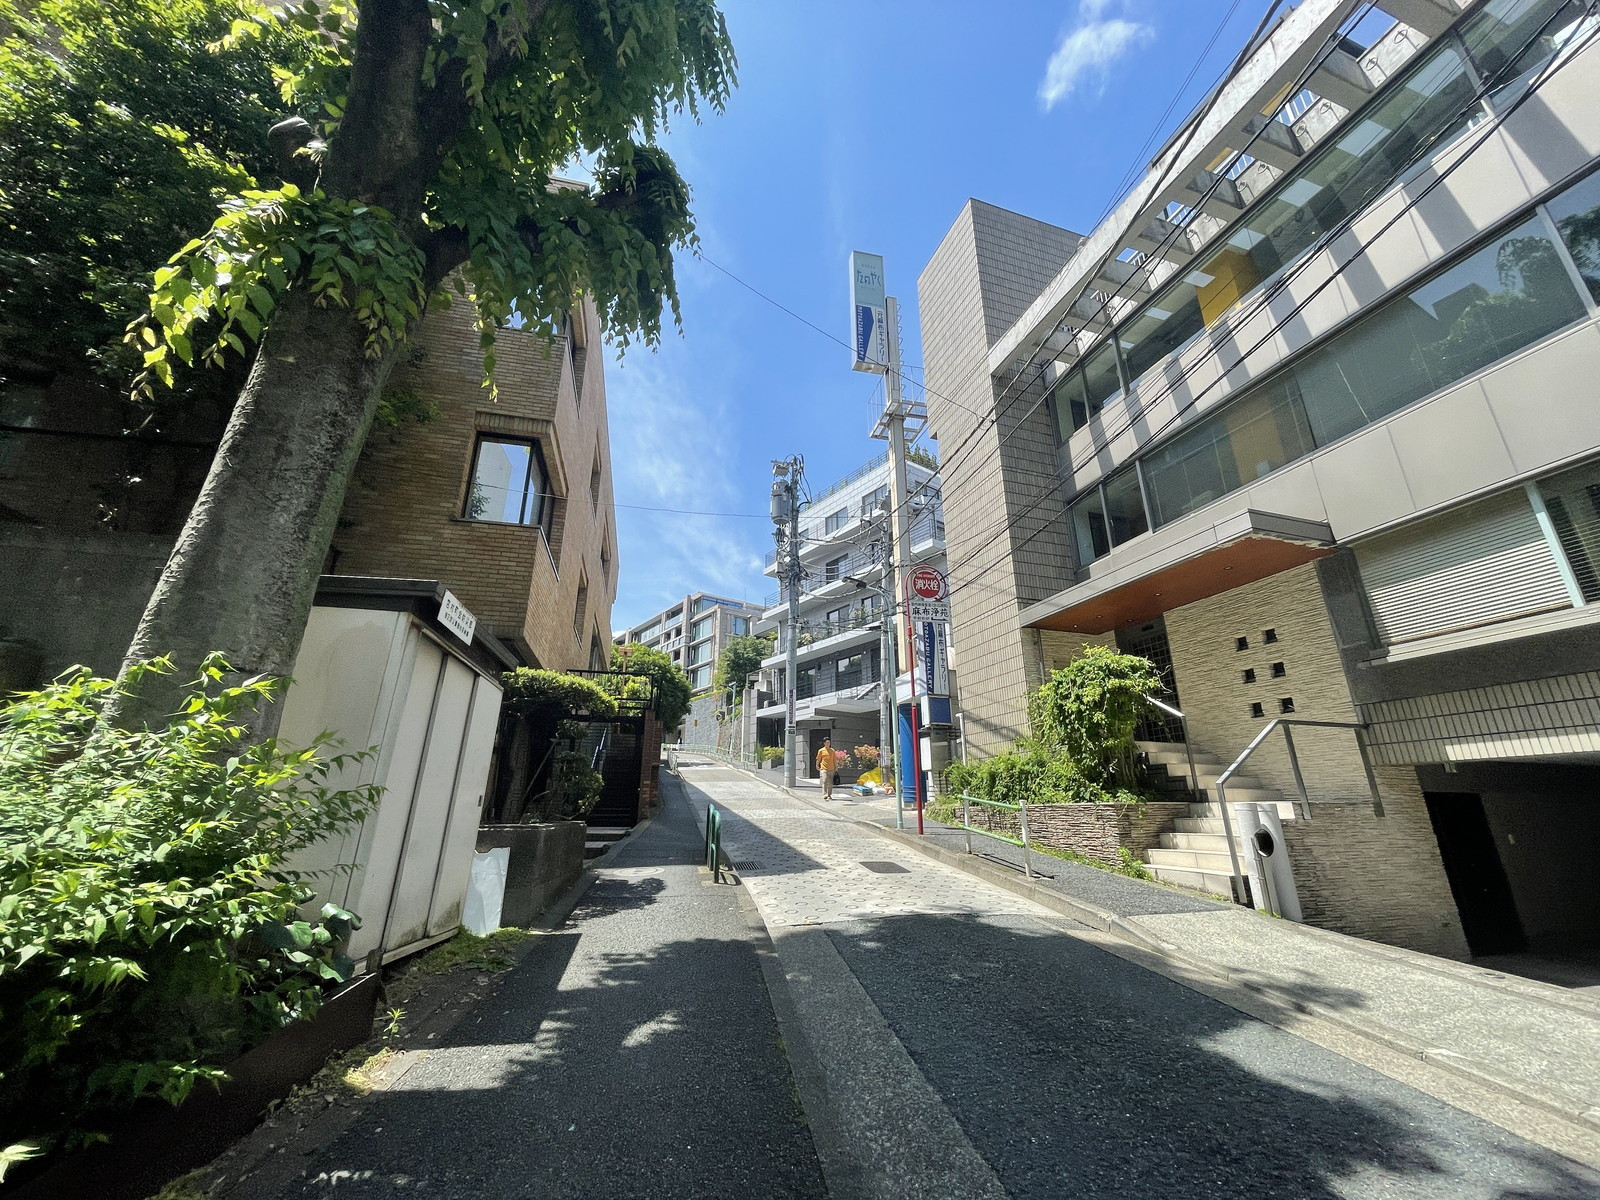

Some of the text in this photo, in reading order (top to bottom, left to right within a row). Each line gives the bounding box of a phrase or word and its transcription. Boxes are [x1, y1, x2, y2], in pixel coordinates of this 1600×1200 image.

[915, 579, 939, 591] 消火栓
[912, 607, 950, 618] 麻布浄苑
